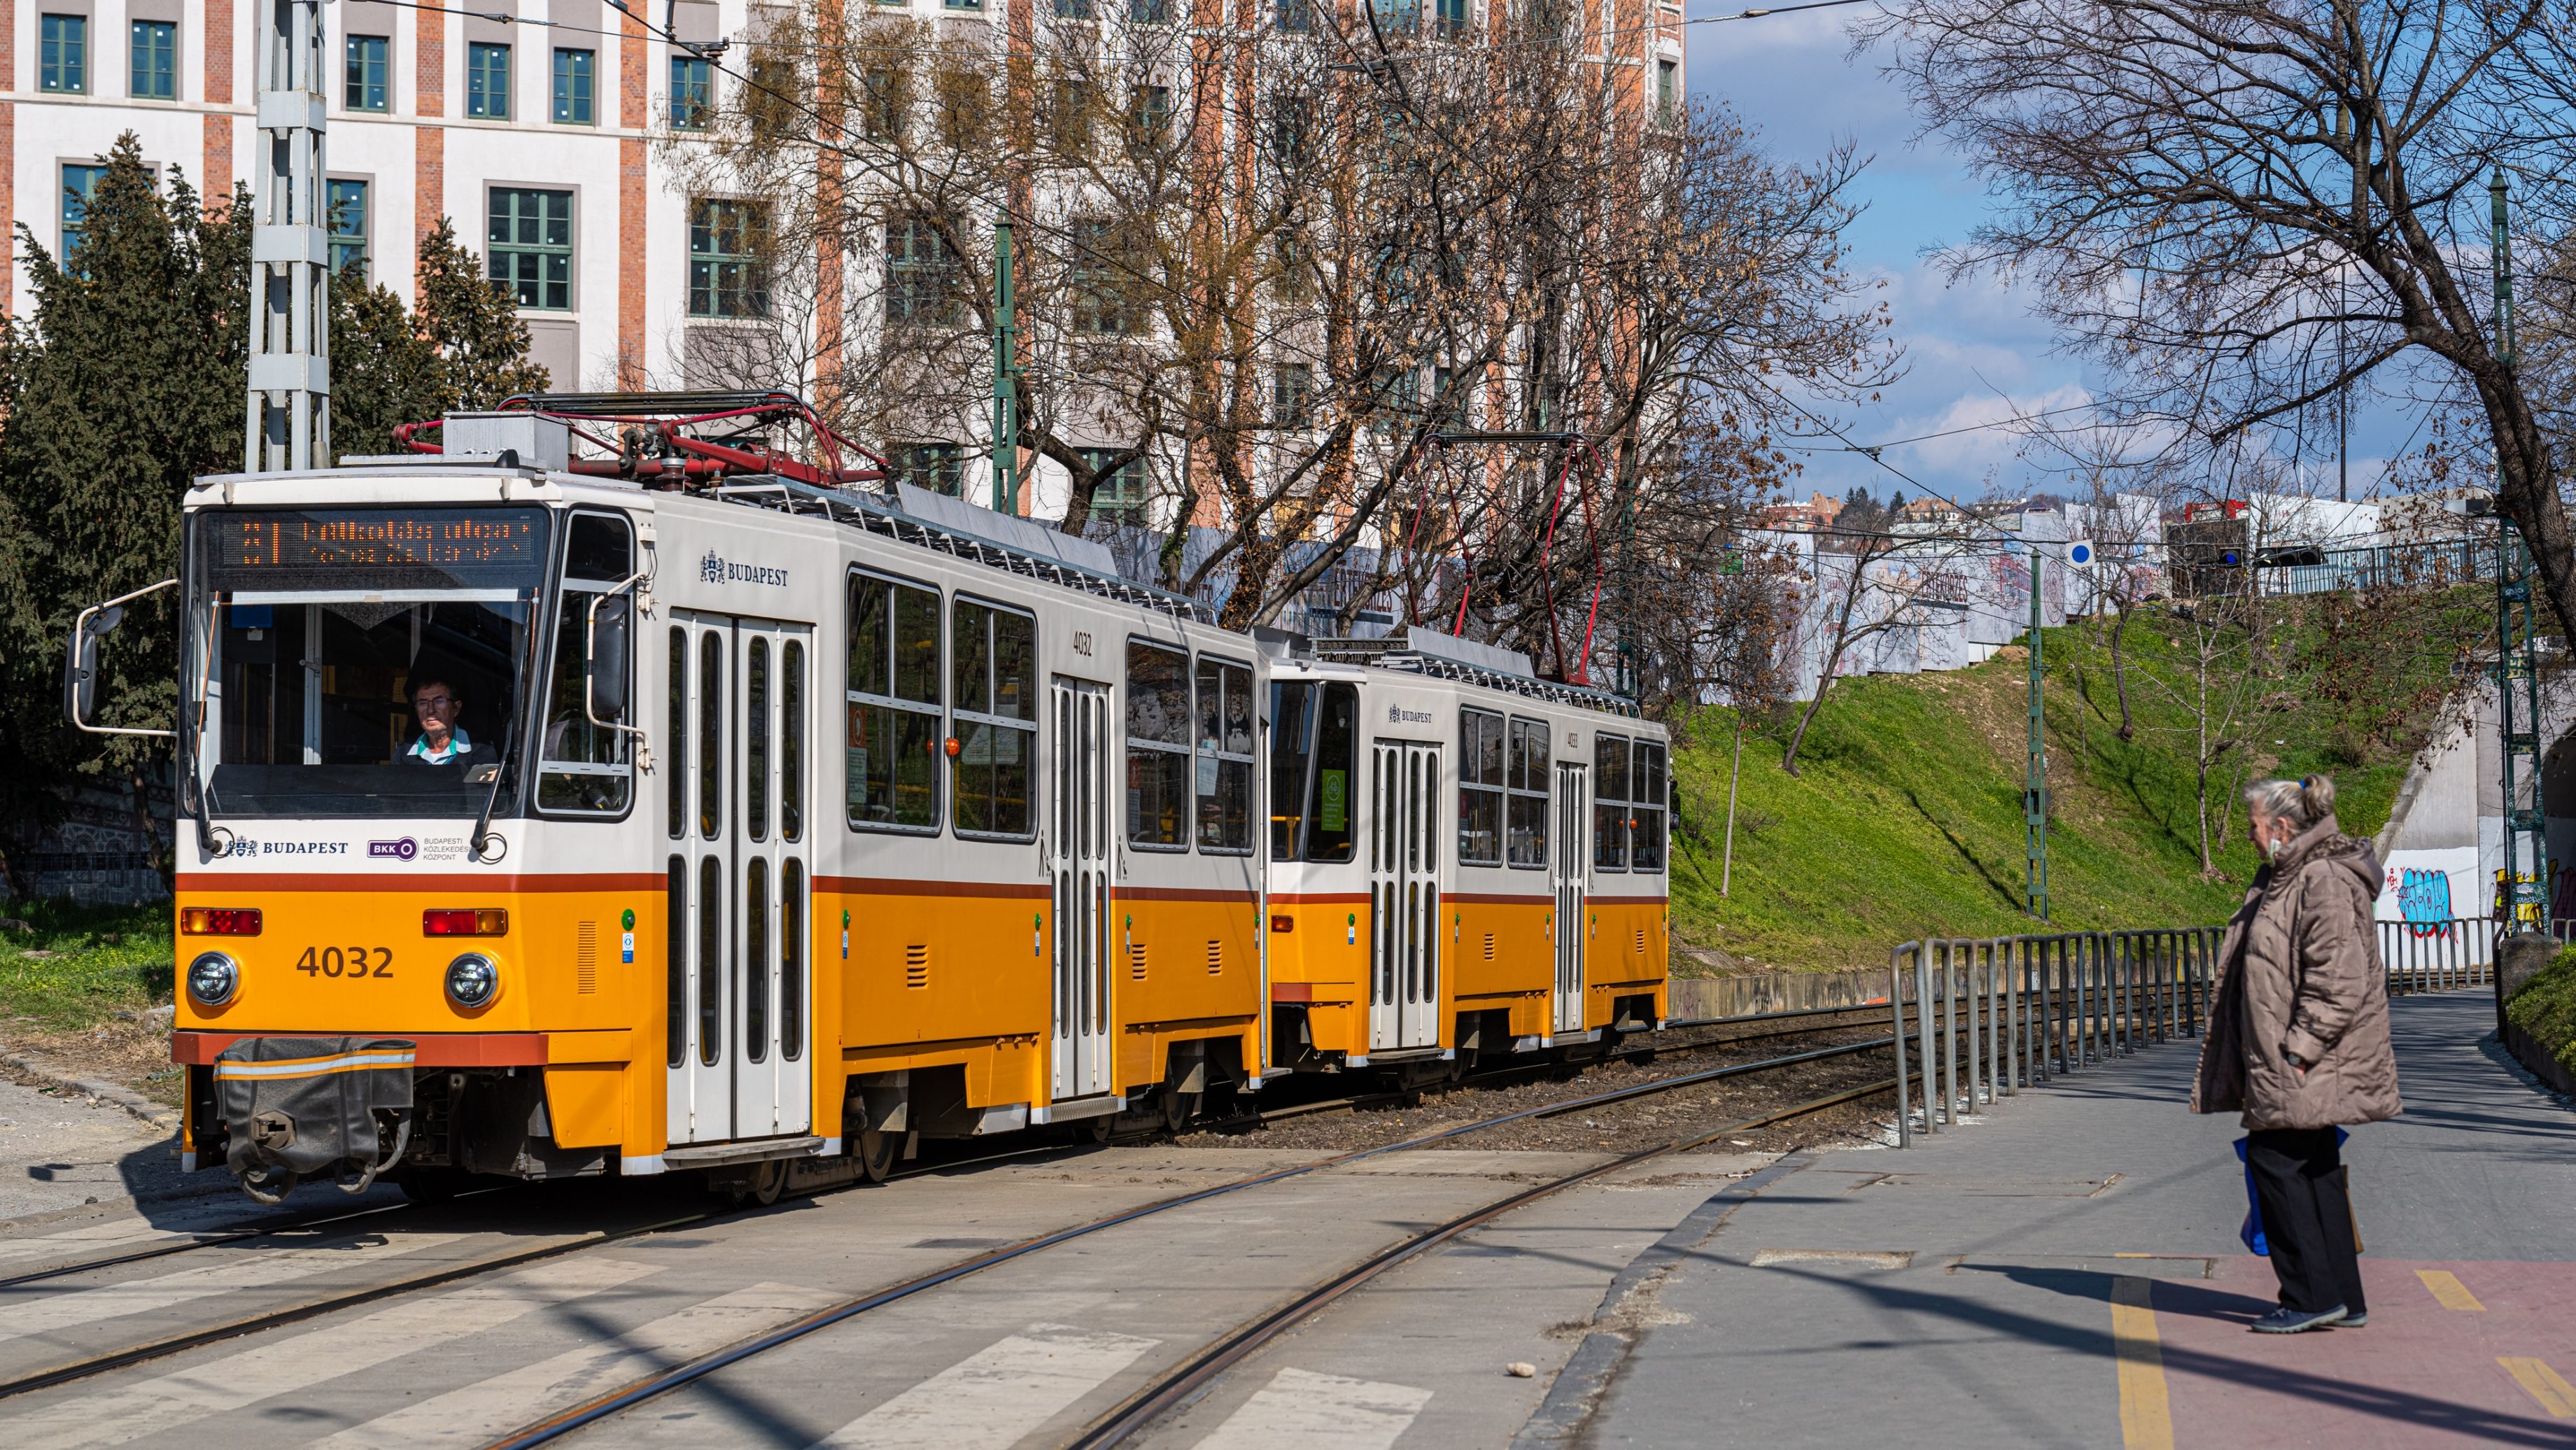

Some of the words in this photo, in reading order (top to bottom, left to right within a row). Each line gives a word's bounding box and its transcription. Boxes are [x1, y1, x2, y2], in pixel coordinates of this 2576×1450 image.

[728, 563, 788, 586] BUDAPEST
[1074, 631, 1092, 657] 4032
[1402, 710, 1432, 724] BUDAPEST
[1568, 732, 1578, 749] 4033
[263, 842, 348, 854] BUDAPEST
[374, 845, 396, 853] BKK
[296, 946, 393, 978] 4032
